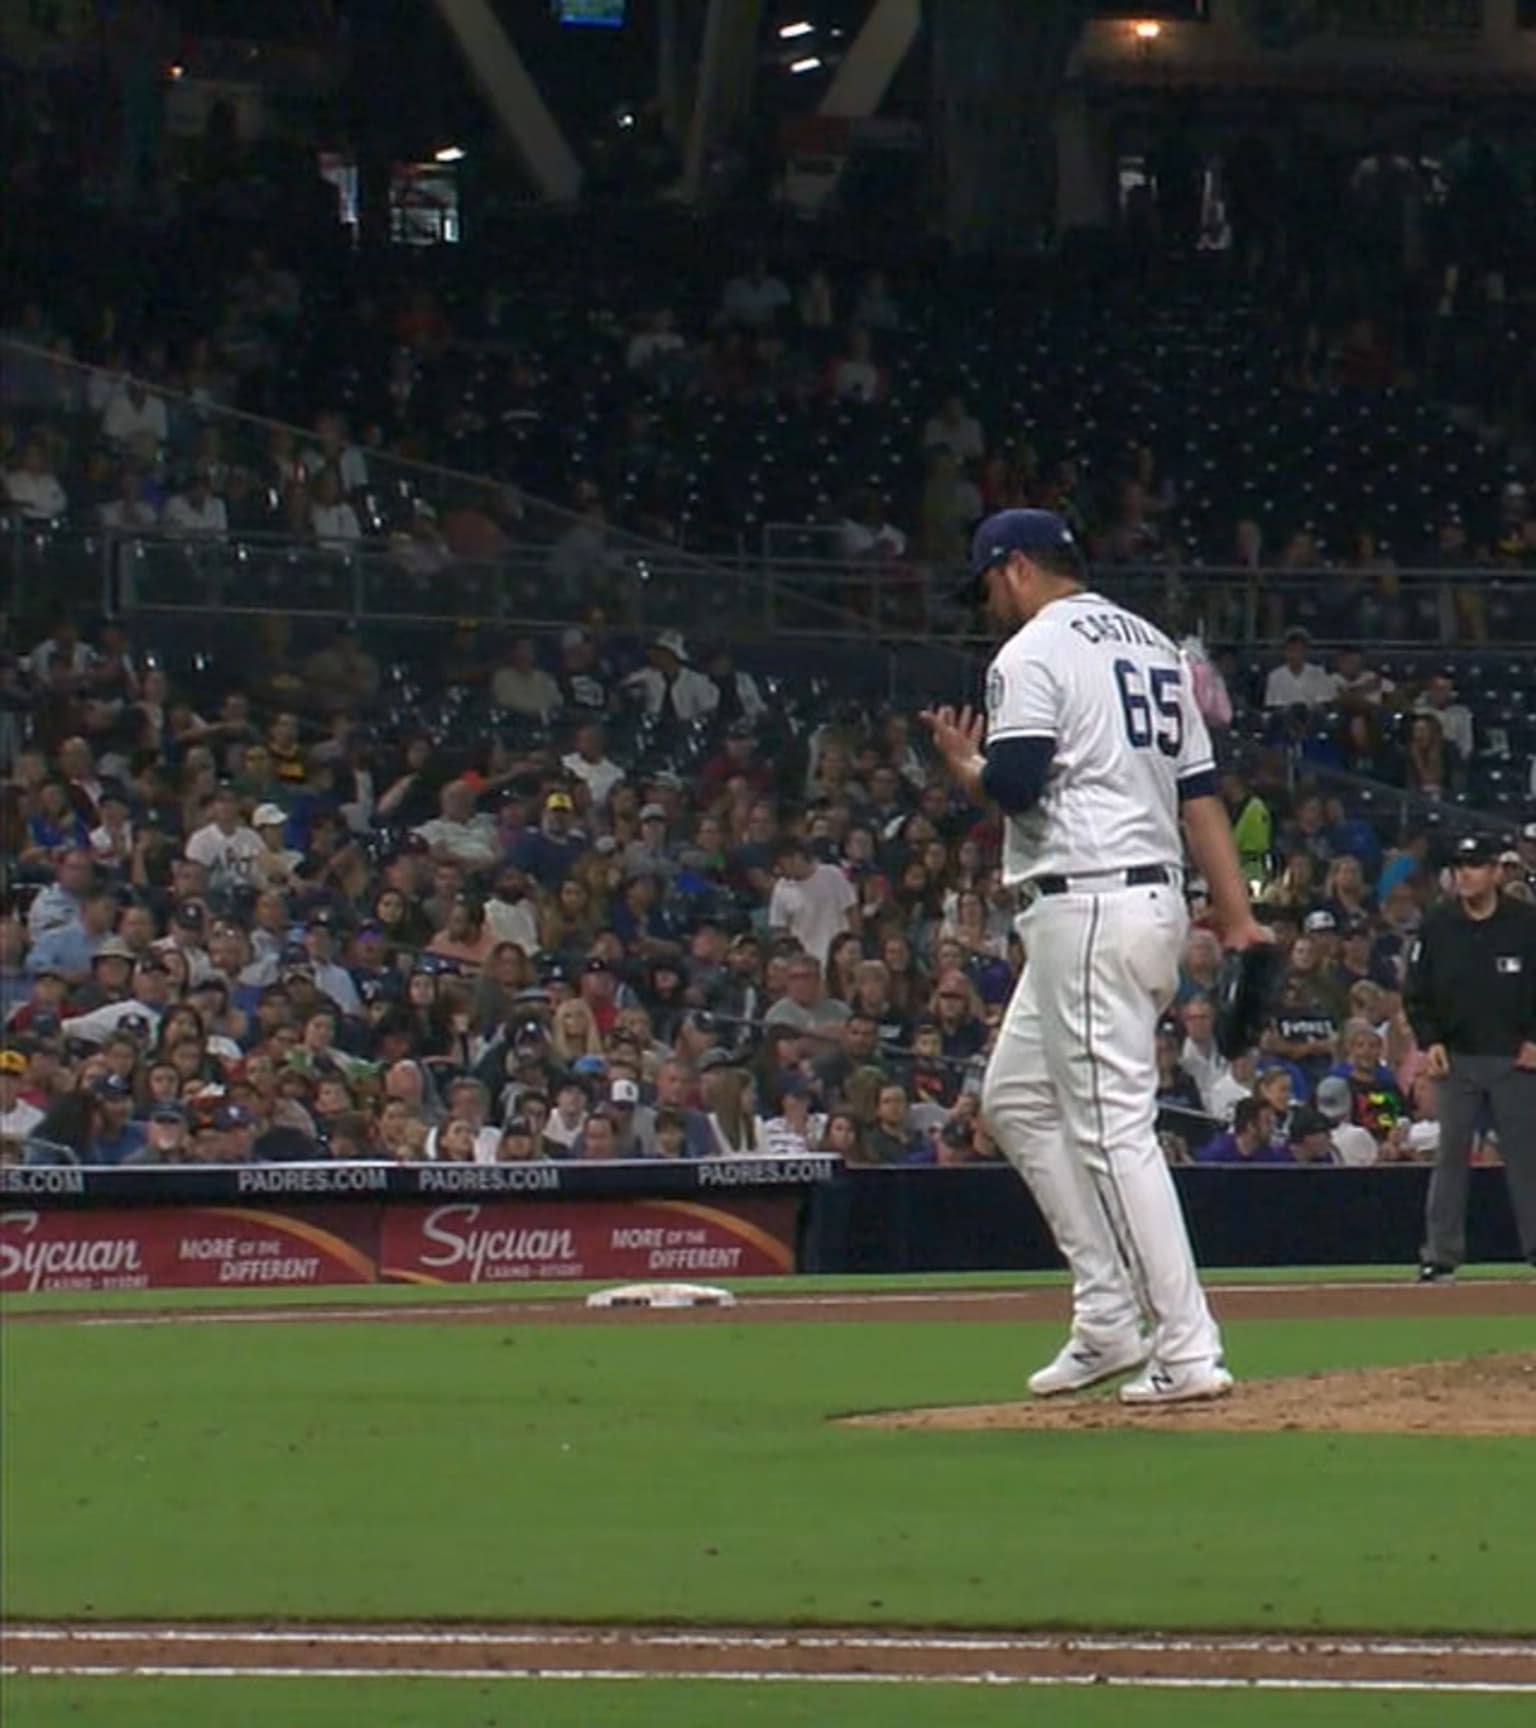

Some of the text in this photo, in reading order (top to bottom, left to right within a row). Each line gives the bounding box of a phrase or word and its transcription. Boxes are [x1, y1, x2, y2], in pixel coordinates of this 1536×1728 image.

[1113, 658, 1184, 757] 65
[238, 1168, 388, 1191] PADRES.COM
[419, 1168, 560, 1190] PADRES.COM
[696, 1161, 832, 1185] PADRES.COM
[179, 1238, 236, 1260] MORE
[420, 1203, 576, 1284] Sycuan
[611, 1228, 664, 1249] MORE
[0, 1212, 143, 1293] Sycuan
[650, 1248, 742, 1270] DIFFERENT
[219, 1258, 320, 1281] DIFFERENT
